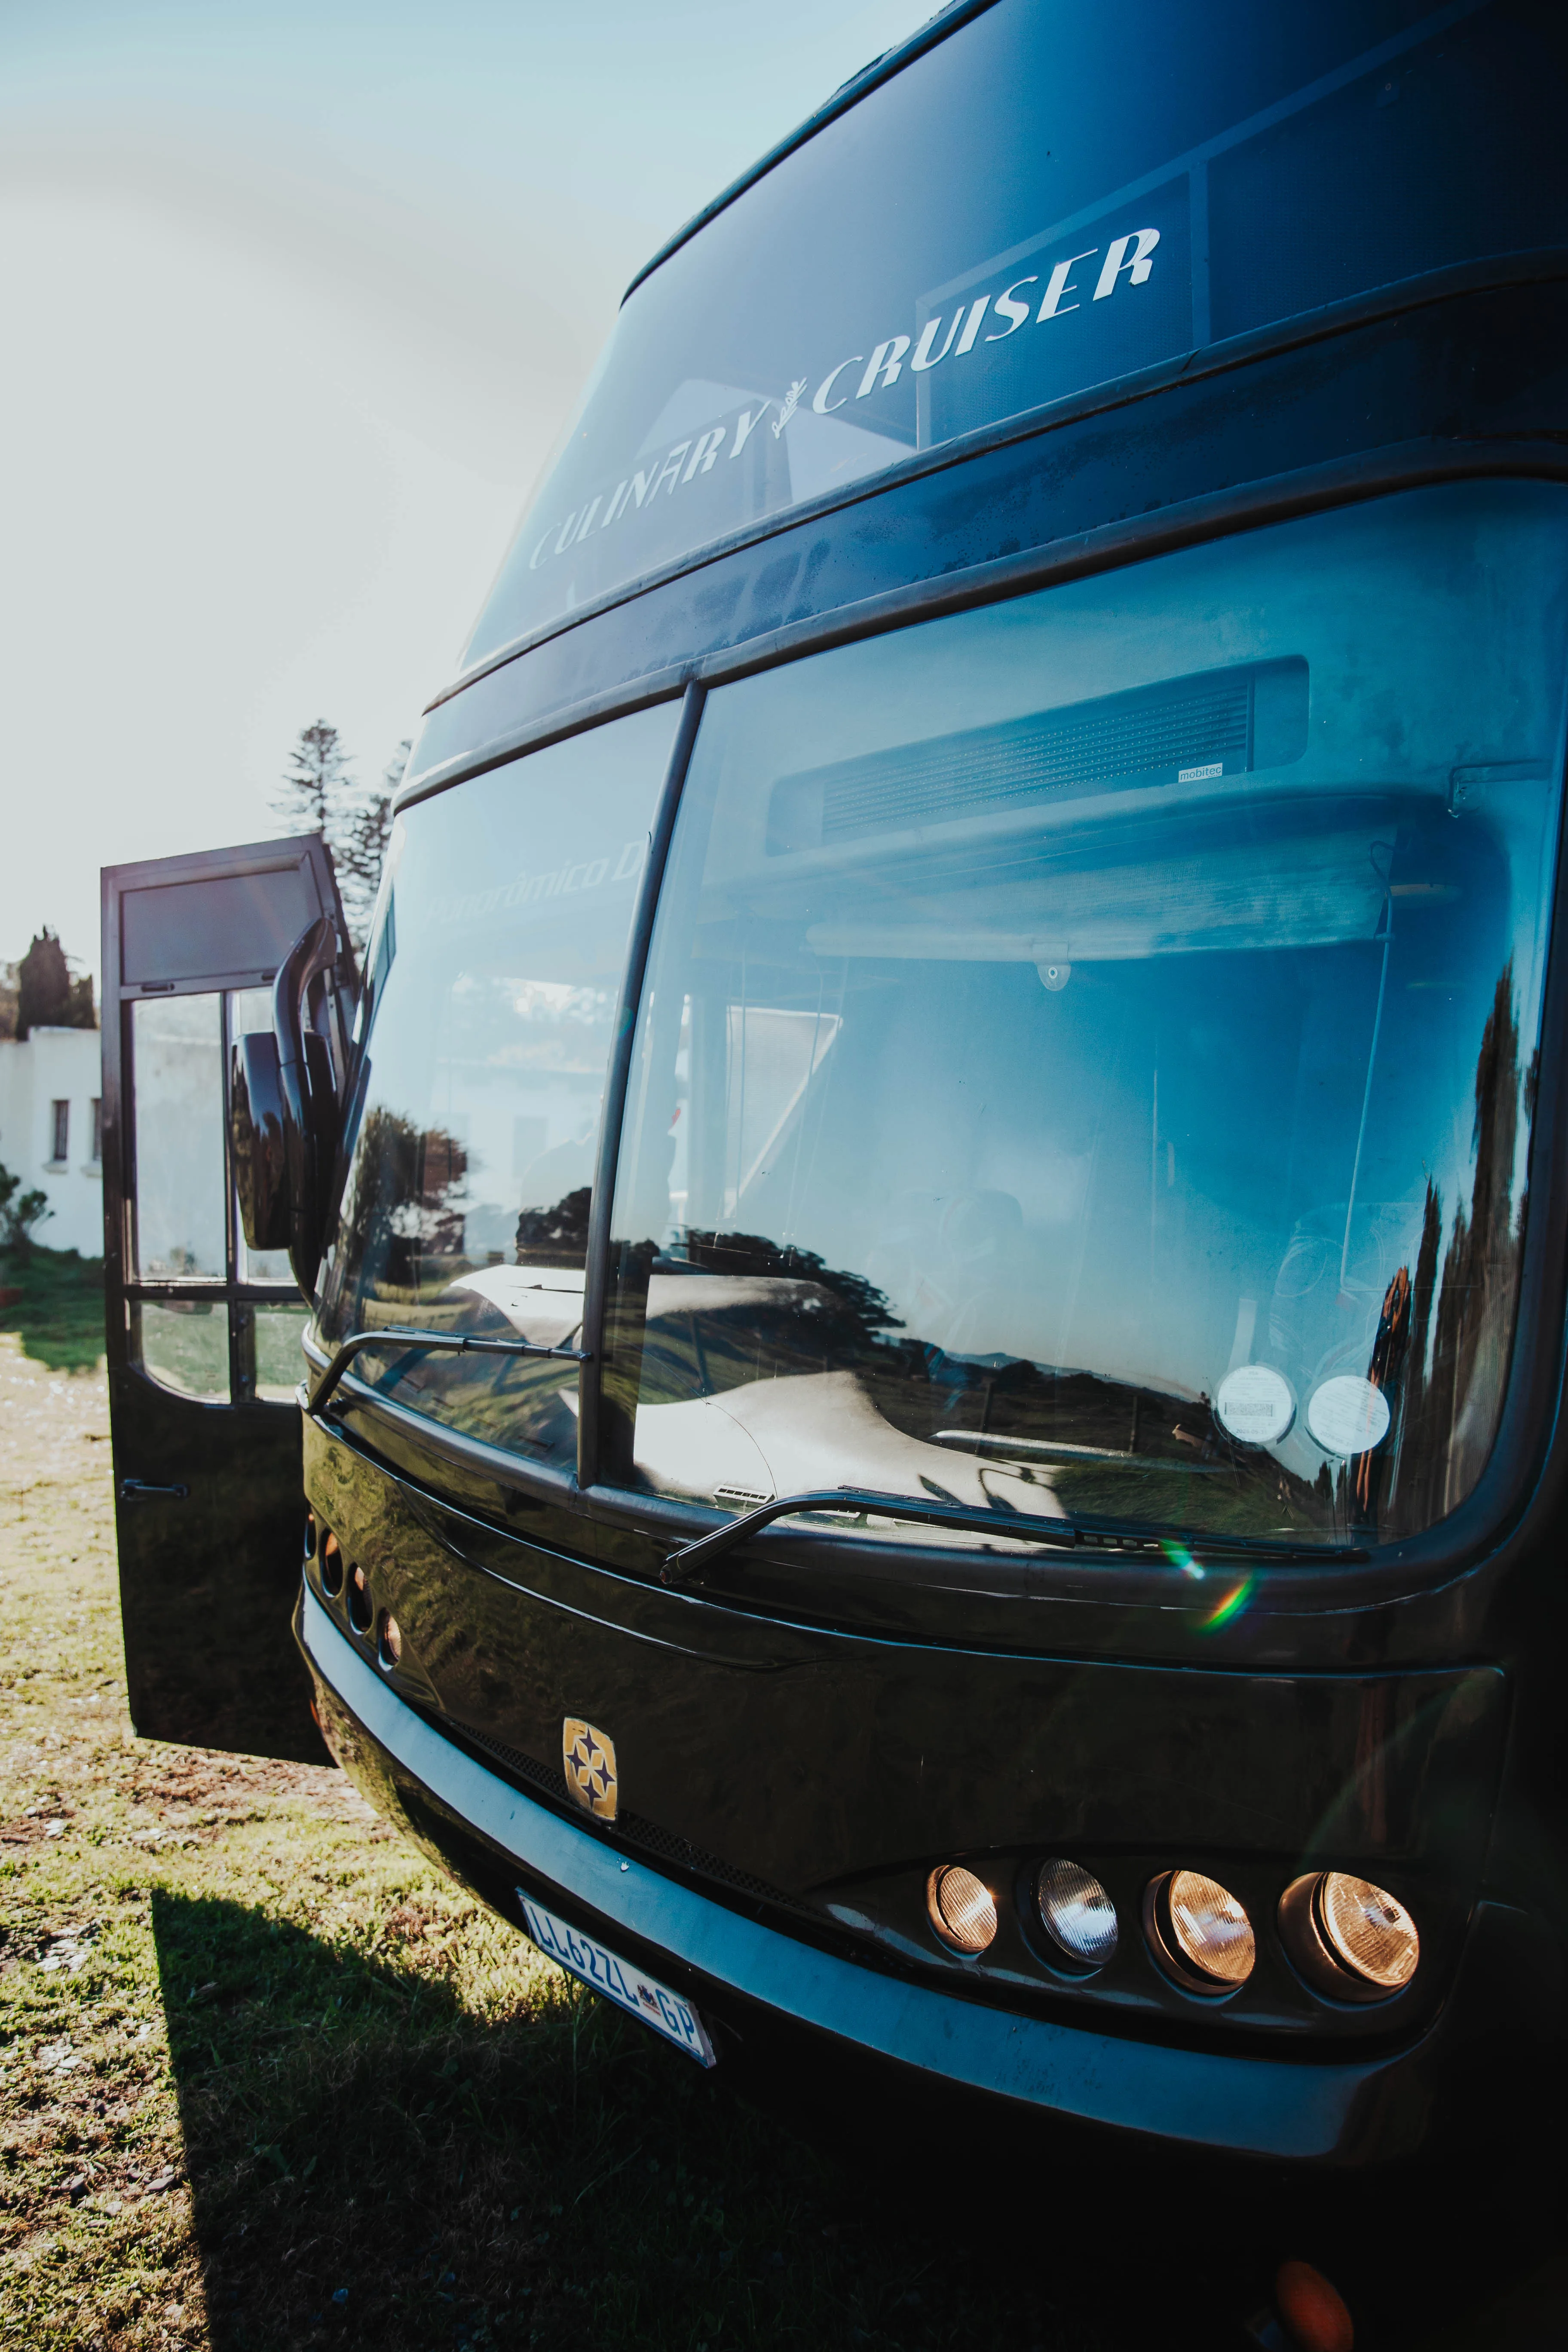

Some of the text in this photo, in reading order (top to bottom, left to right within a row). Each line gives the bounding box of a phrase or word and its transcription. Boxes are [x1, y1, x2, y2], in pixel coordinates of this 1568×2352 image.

[529, 228, 1161, 570] CULINARY CRUISER
[1180, 767, 1222, 781] mobitec
[655, 1988, 695, 2043] GP
